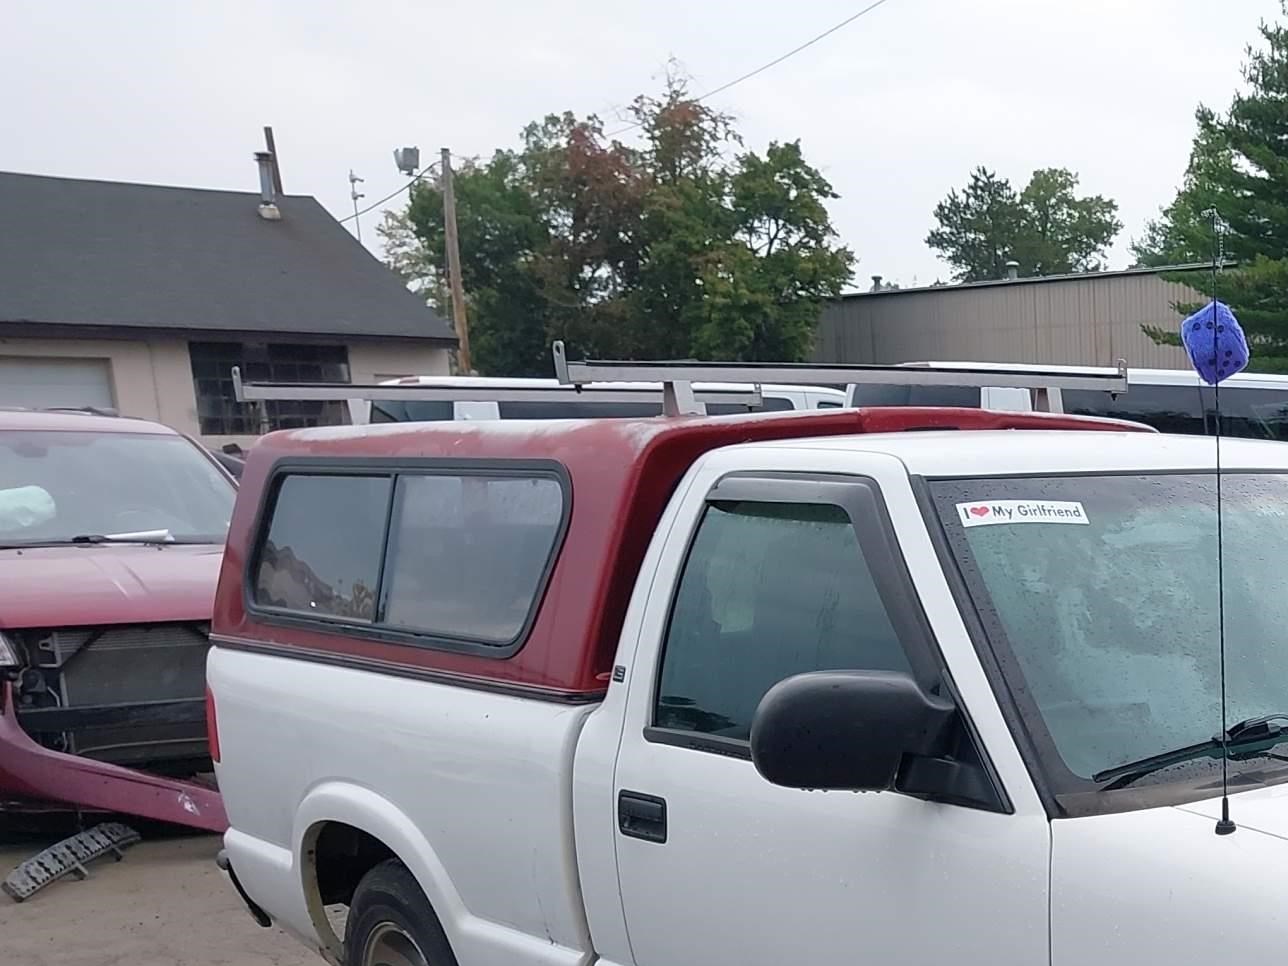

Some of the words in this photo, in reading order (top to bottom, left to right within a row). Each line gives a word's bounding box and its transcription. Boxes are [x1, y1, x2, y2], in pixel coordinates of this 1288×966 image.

[963, 507, 970, 519] I
[992, 505, 1013, 519] My
[1017, 504, 1081, 518] Girlfriend
